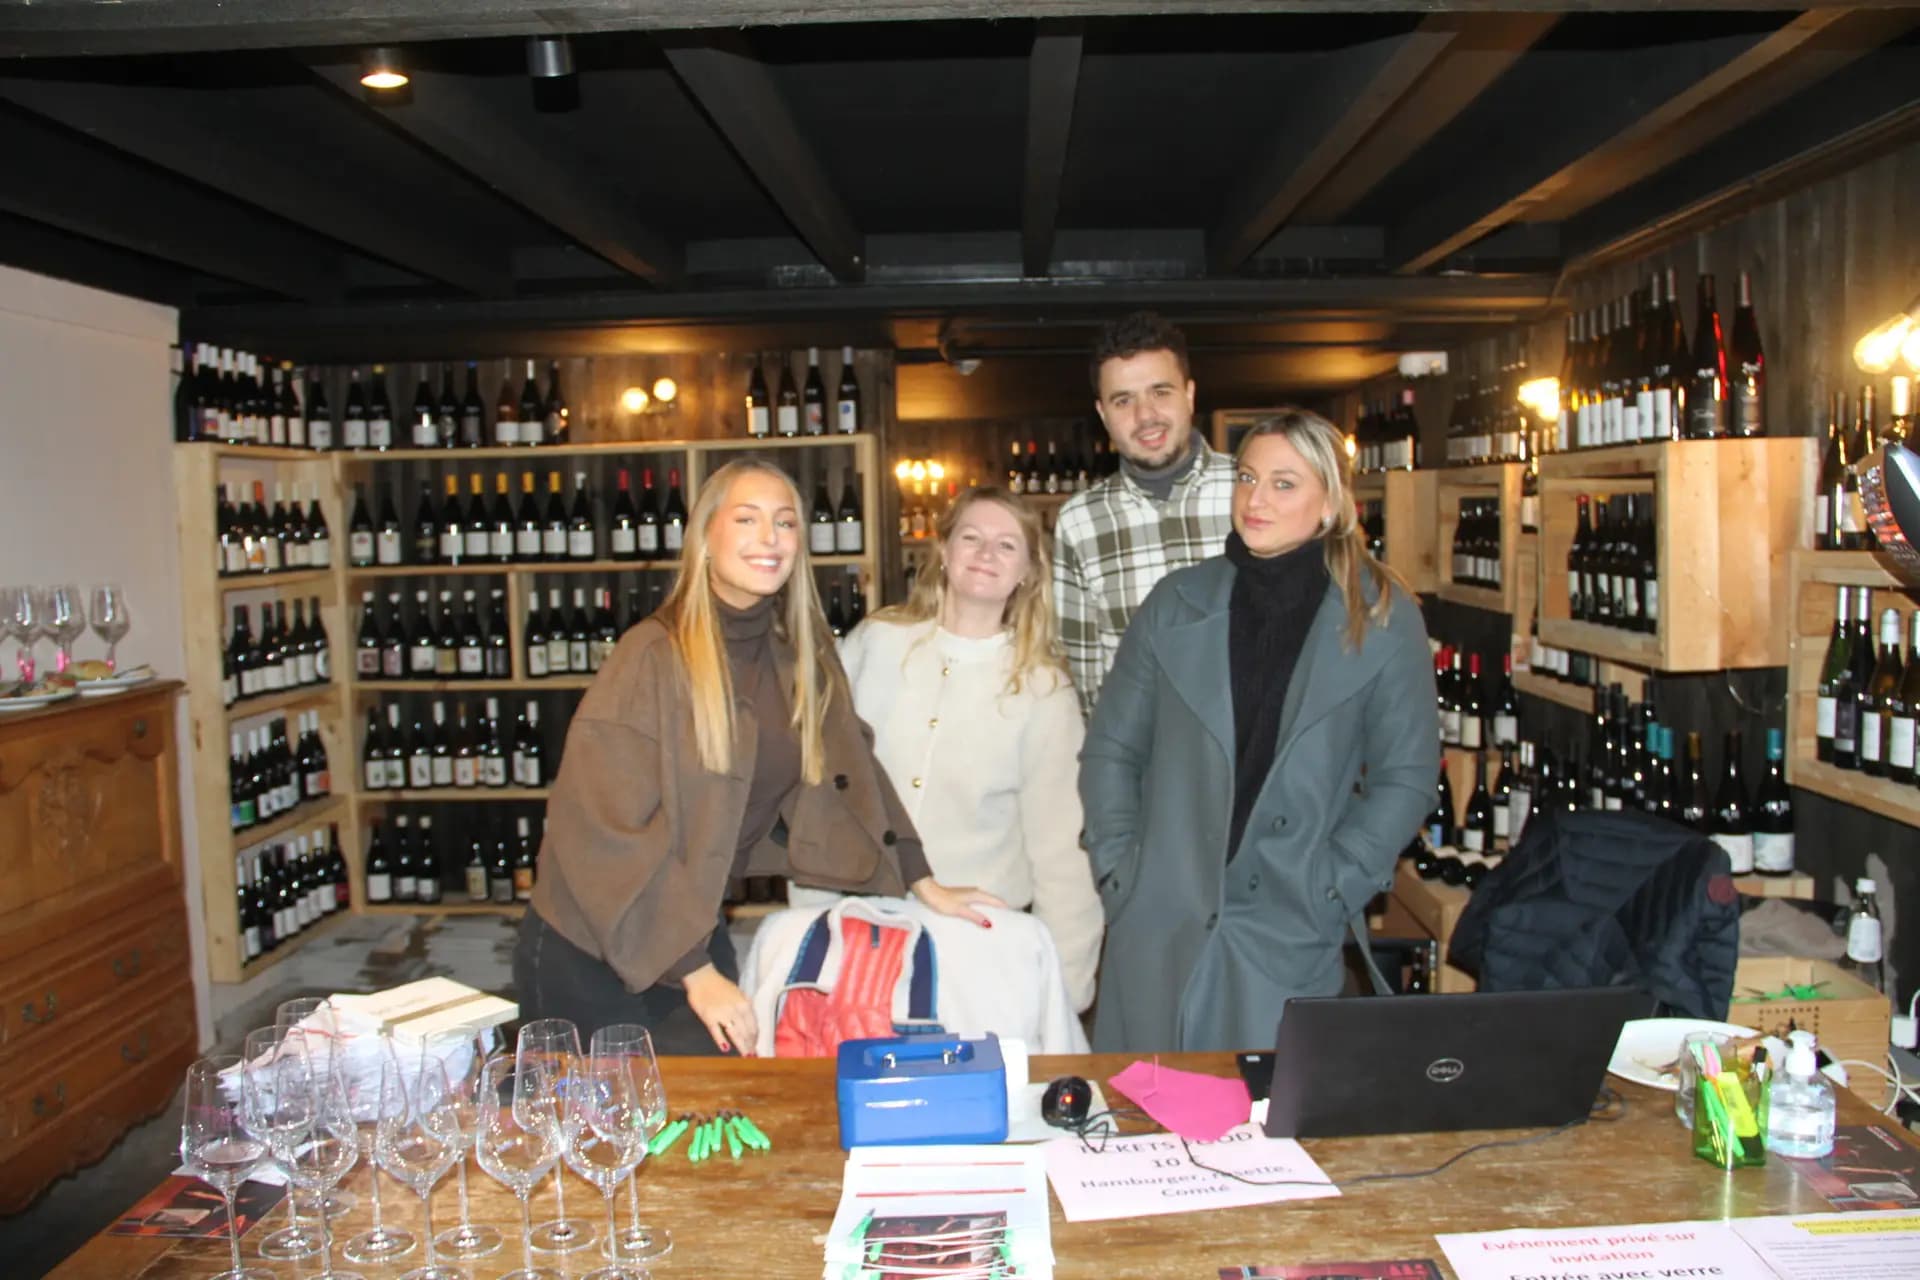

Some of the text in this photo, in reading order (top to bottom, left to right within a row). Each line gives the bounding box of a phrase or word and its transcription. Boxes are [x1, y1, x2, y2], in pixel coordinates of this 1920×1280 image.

[1152, 1158, 1180, 1168] 10
[1607, 1232, 1658, 1247] privé
[1665, 1232, 1697, 1242] sur
[1551, 1250, 1655, 1265] invitation
[1599, 1269, 1651, 1280] avec
[1658, 1265, 1724, 1278] verre
